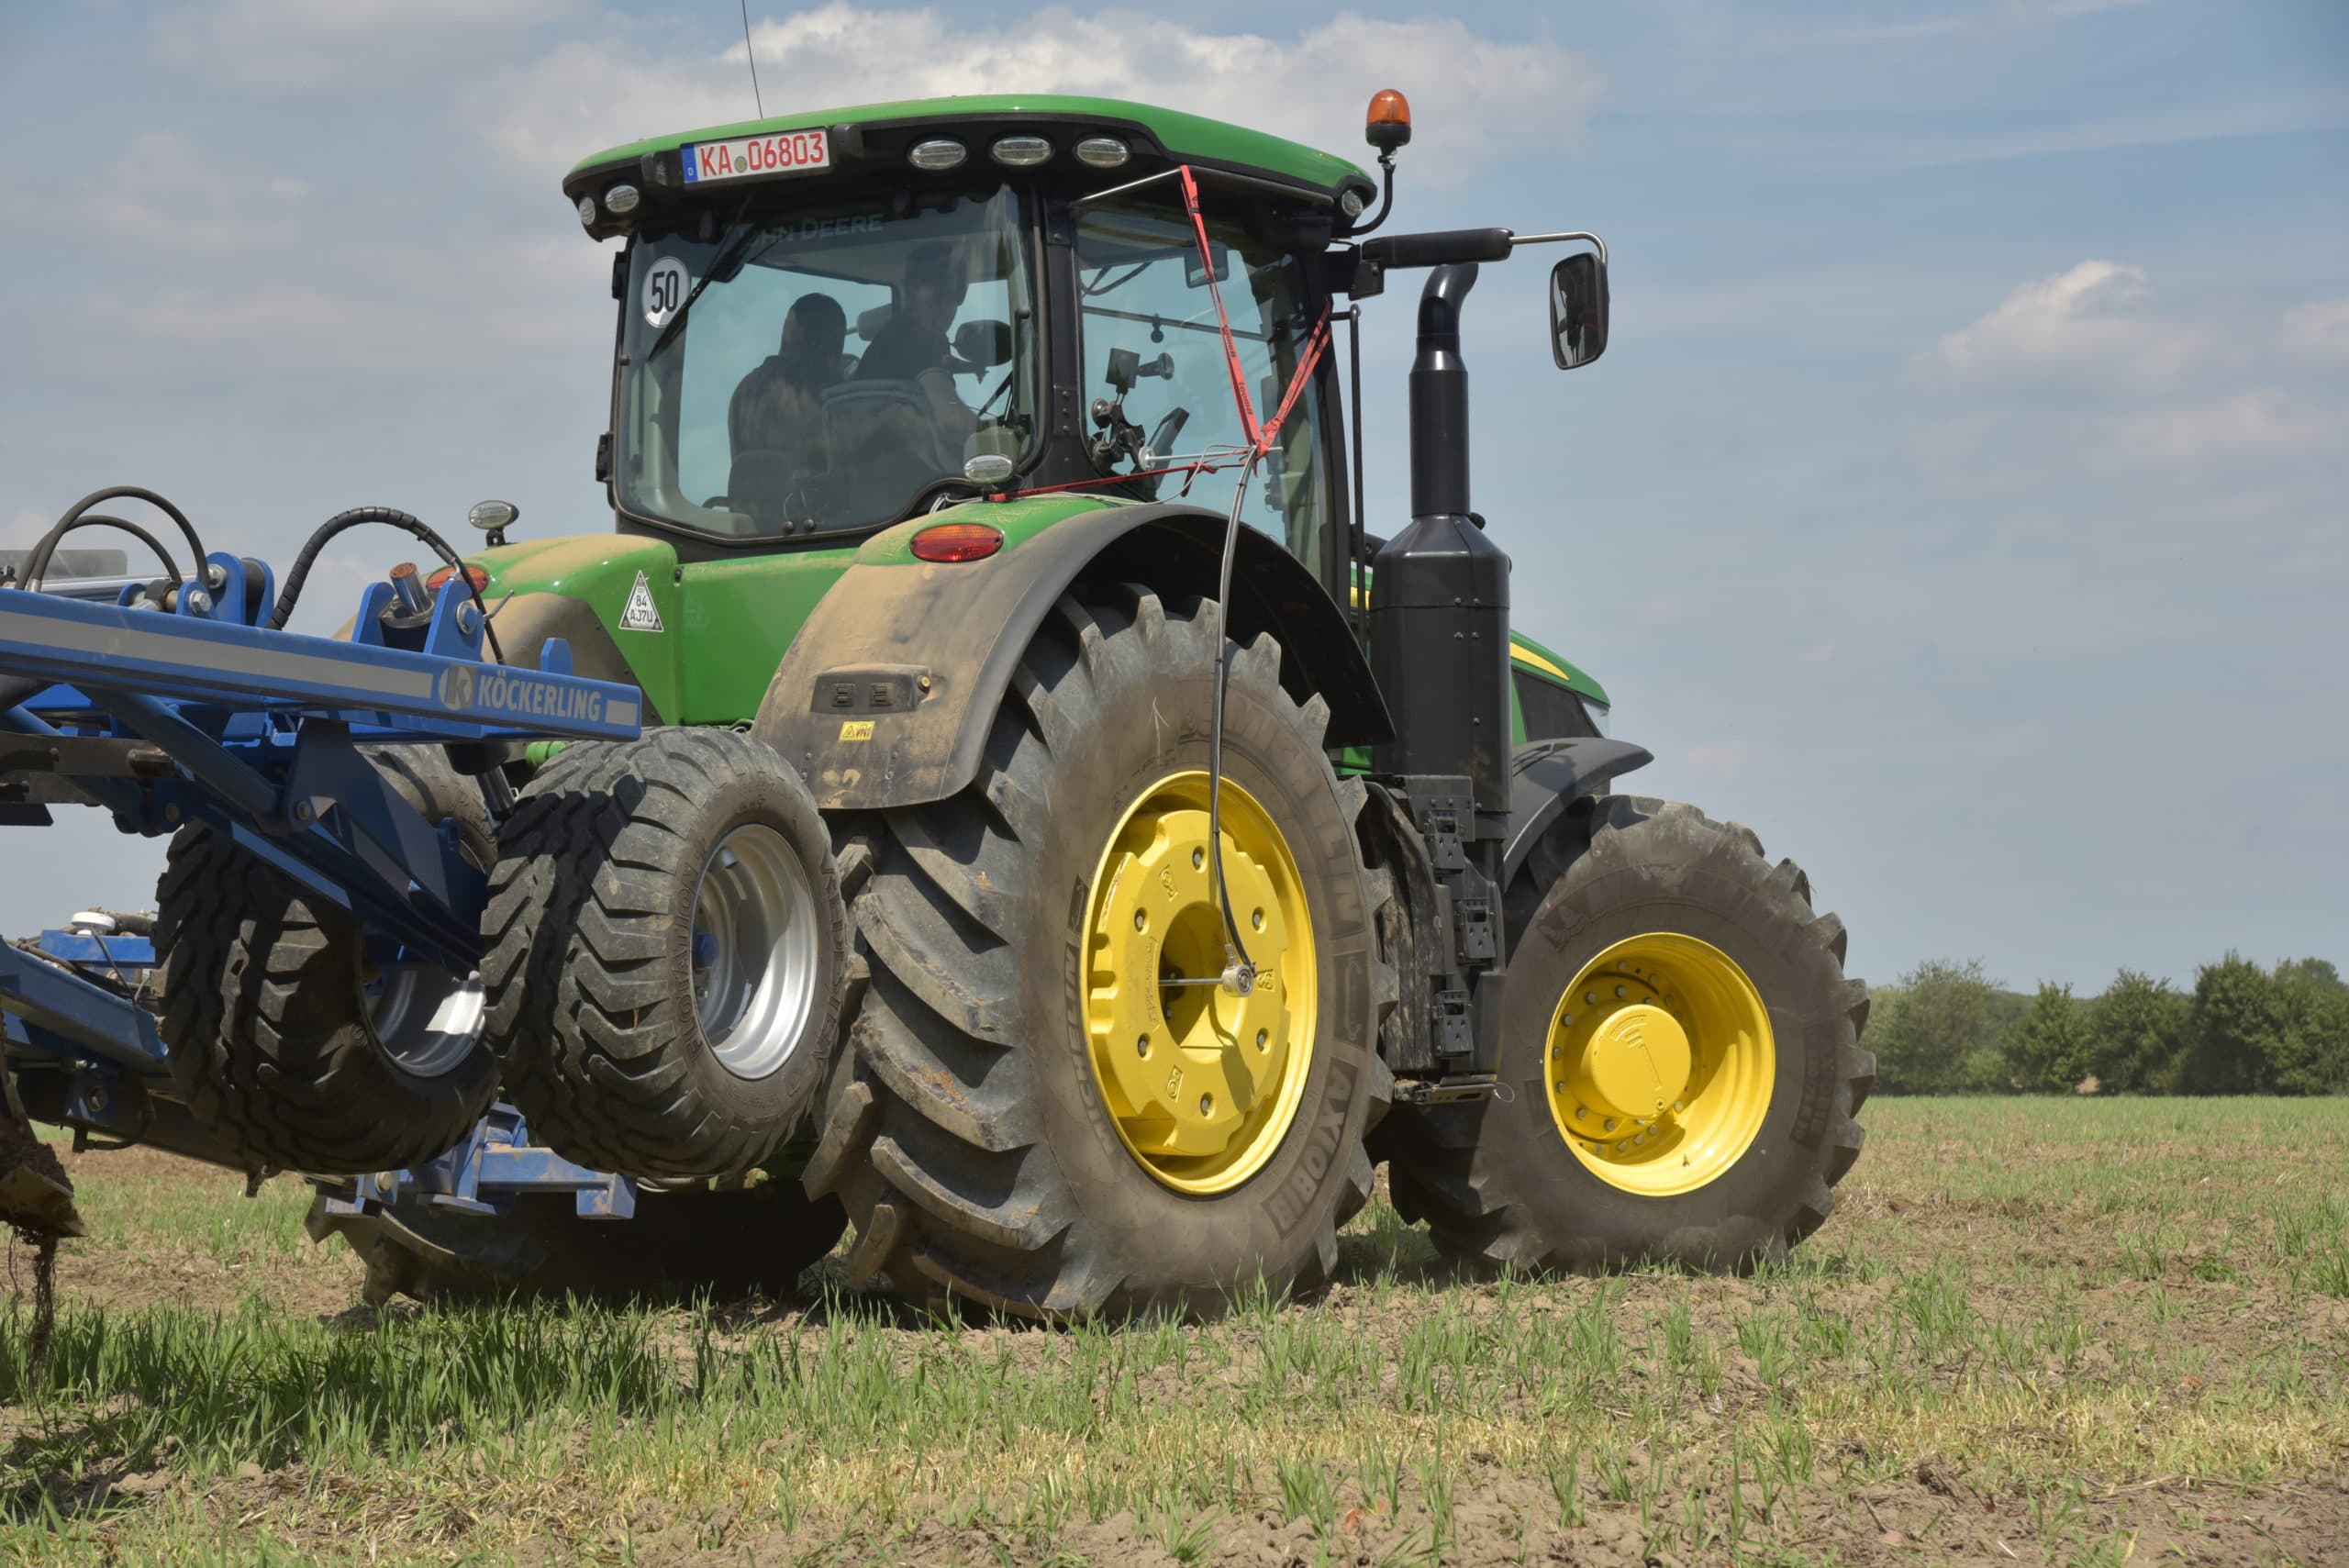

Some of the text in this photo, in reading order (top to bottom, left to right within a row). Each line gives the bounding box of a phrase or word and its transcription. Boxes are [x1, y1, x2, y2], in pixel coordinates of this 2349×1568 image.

[688, 167, 695, 176] D
[700, 132, 824, 176] KA 06803
[801, 214, 885, 240] DEERE
[651, 270, 679, 314] 50
[478, 669, 602, 722] KÖCKERLING
[1064, 946, 1118, 1162] MICHELIN
[1271, 1065, 1354, 1234] AXIOBIB
